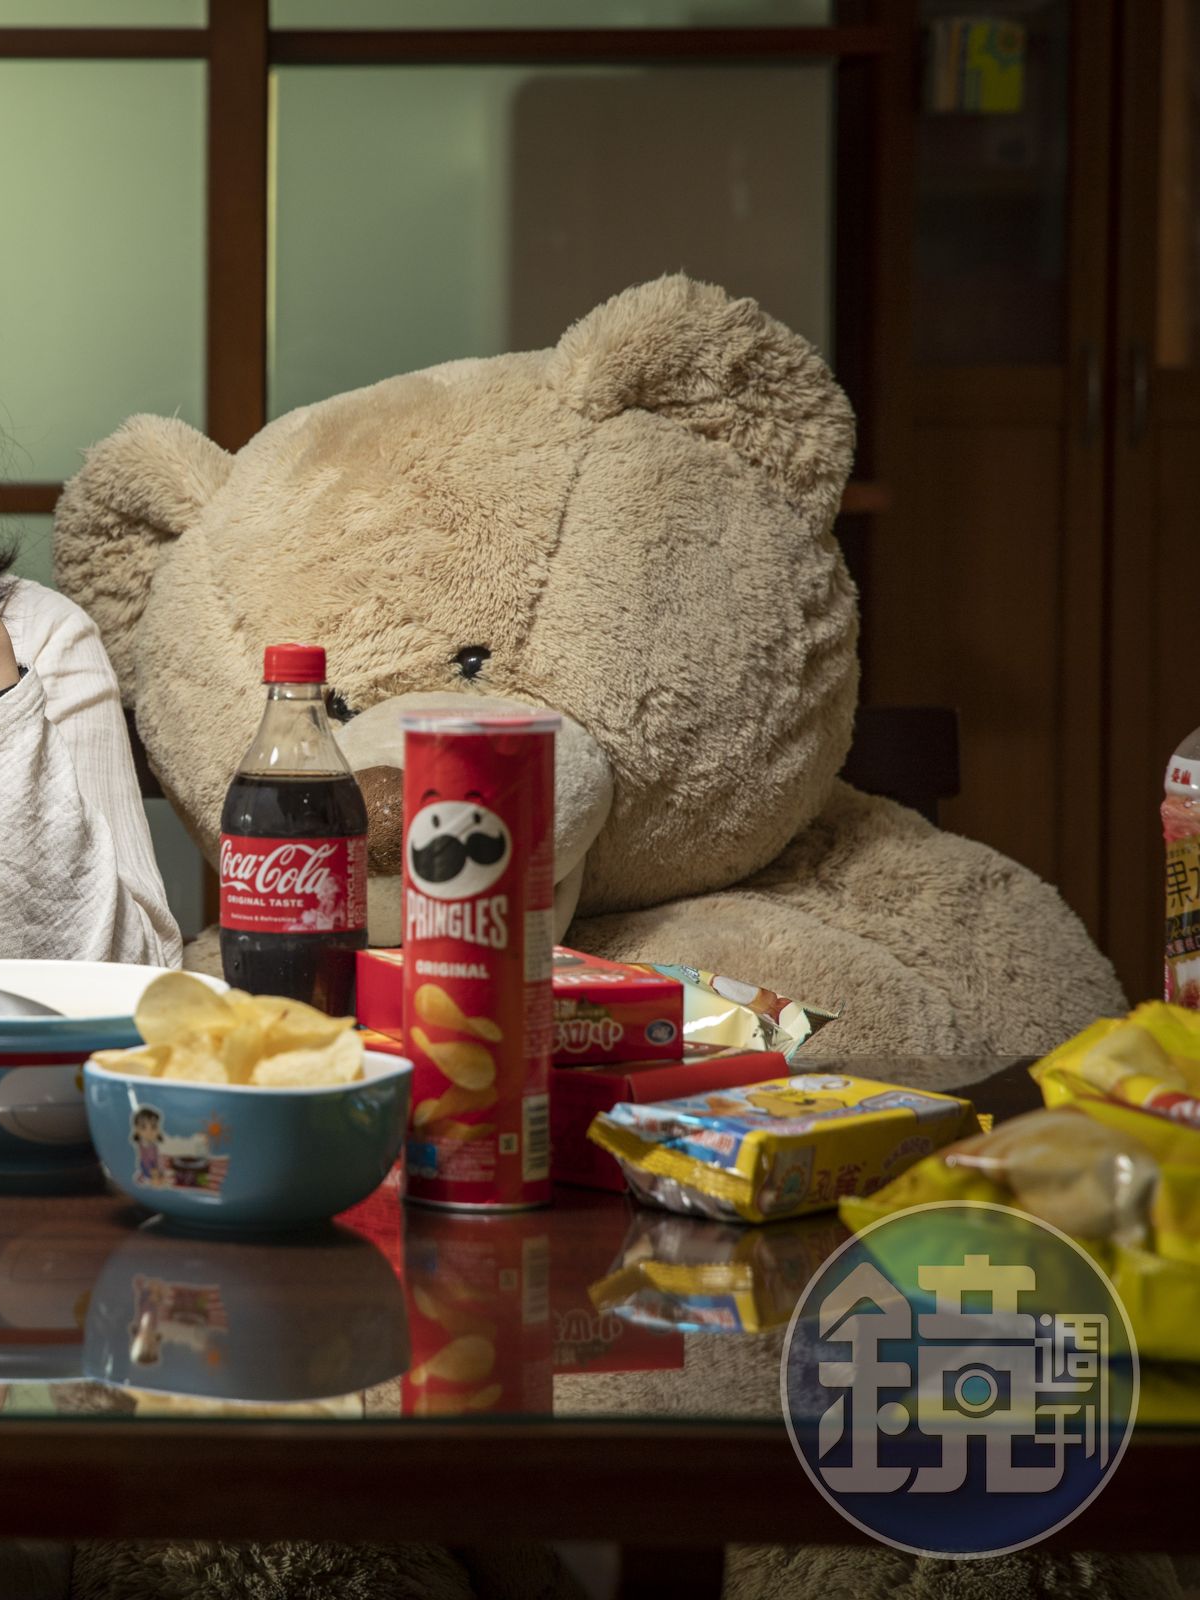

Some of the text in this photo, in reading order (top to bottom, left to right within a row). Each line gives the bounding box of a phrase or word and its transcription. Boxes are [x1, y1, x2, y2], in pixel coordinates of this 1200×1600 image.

[220, 839, 339, 894] Coca-Cola
[227, 894, 304, 908] ORIGINAL TASTE
[406, 887, 508, 949] PRINGLES
[415, 959, 490, 979] ORIGINAL
